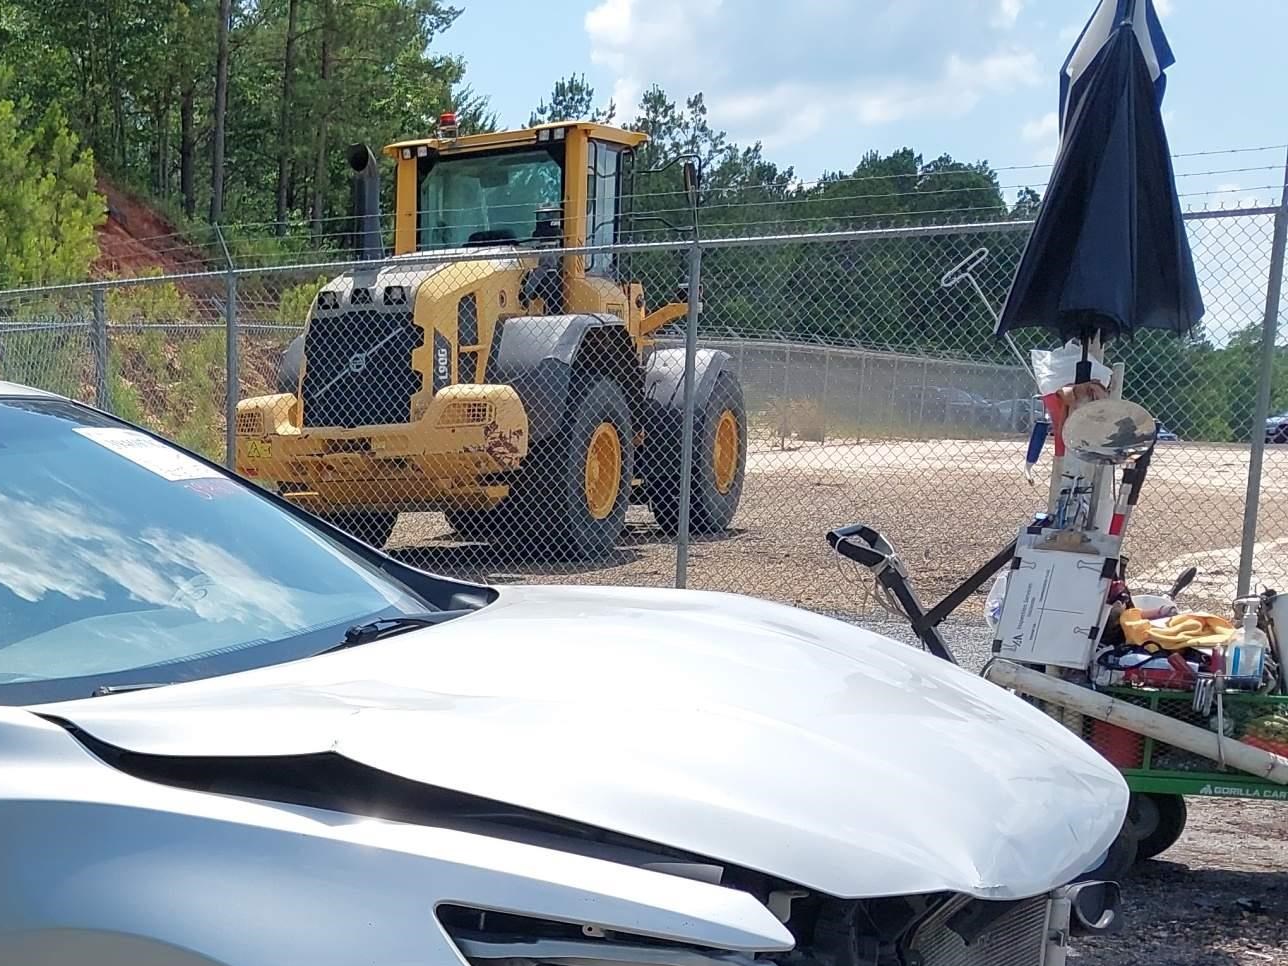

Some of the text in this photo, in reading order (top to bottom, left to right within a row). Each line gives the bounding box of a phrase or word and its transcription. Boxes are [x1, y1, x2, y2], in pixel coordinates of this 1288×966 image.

[437, 348, 449, 380] L90G
[1214, 786, 1288, 799] GORILLA CAR
